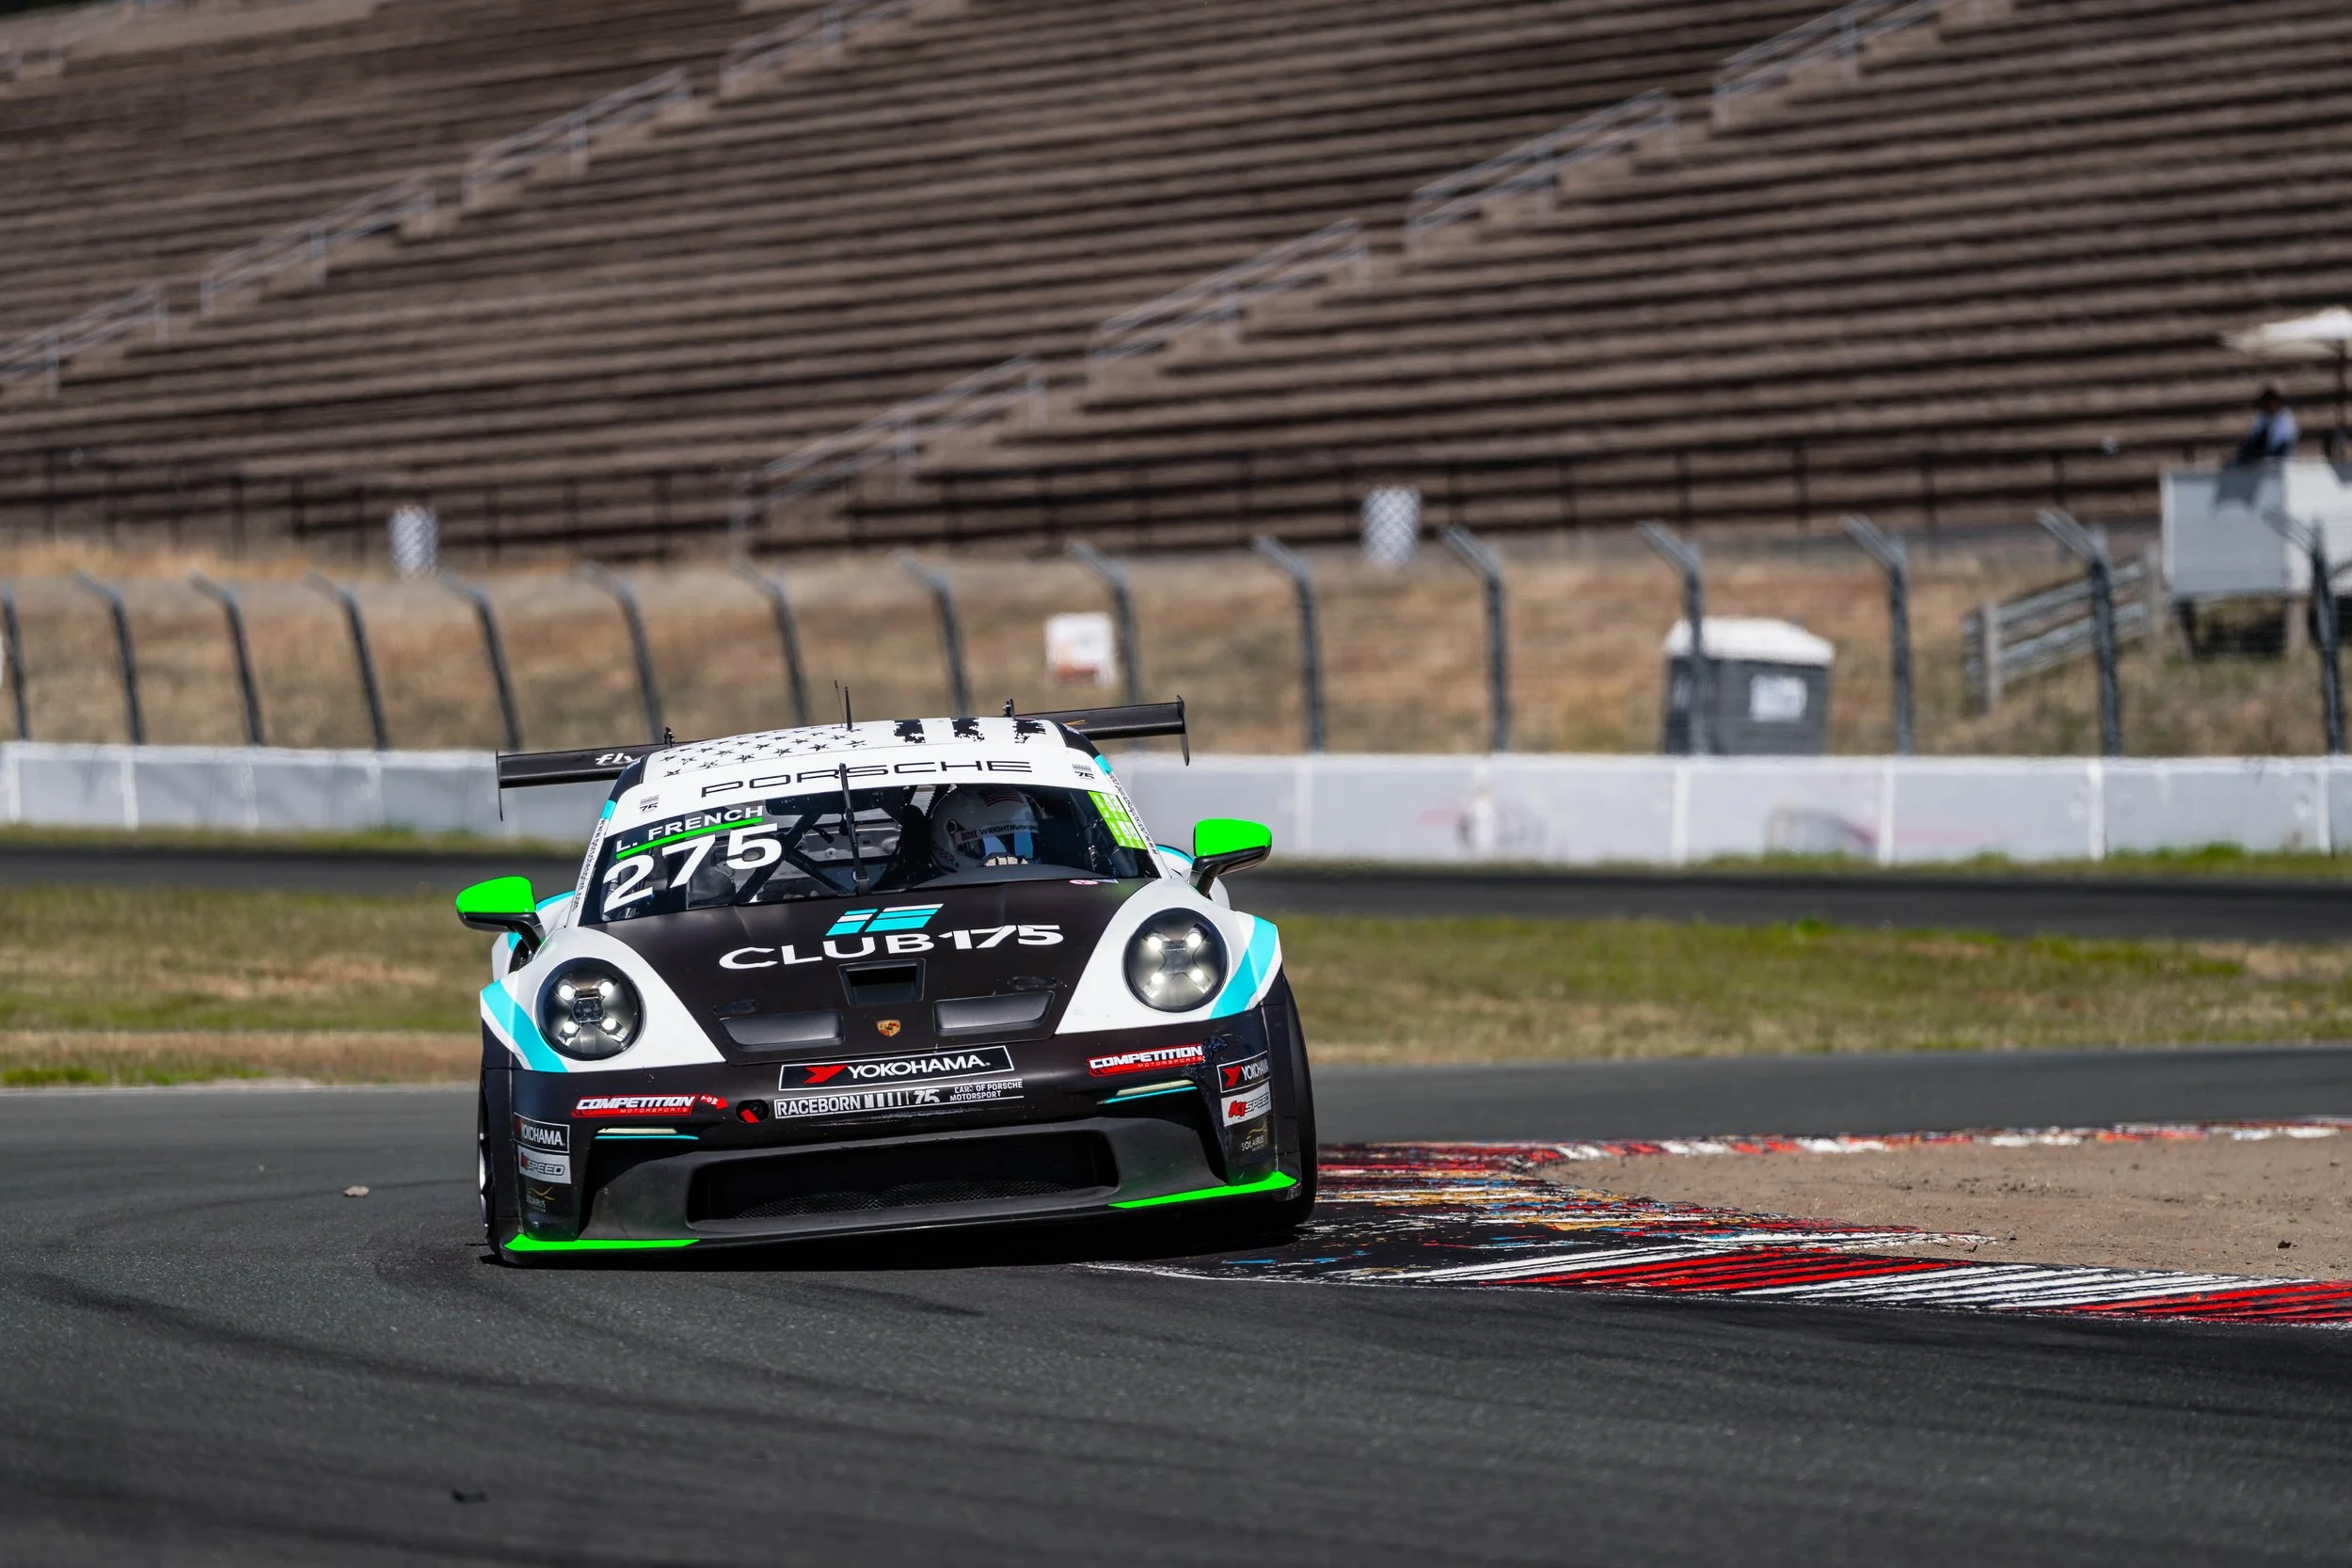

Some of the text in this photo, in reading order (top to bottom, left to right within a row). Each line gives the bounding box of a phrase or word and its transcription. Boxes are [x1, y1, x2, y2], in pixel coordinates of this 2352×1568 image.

[701, 760, 1033, 798] PORSCHE
[616, 805, 763, 852] L. FRENCH
[602, 823, 782, 913] 275
[847, 1054, 985, 1080] YOKOHAMA
[1089, 1045, 1203, 1069] COMPETITION
[1137, 1056, 1202, 1068] MOTORSPORTS
[949, 1090, 1001, 1101] MOTORSPORT
[976, 1084, 986, 1092] OF
[987, 1081, 1023, 1091] PORSCHE
[576, 1096, 695, 1111] COMPETITION
[777, 1088, 940, 1117] RACEBORN 75
